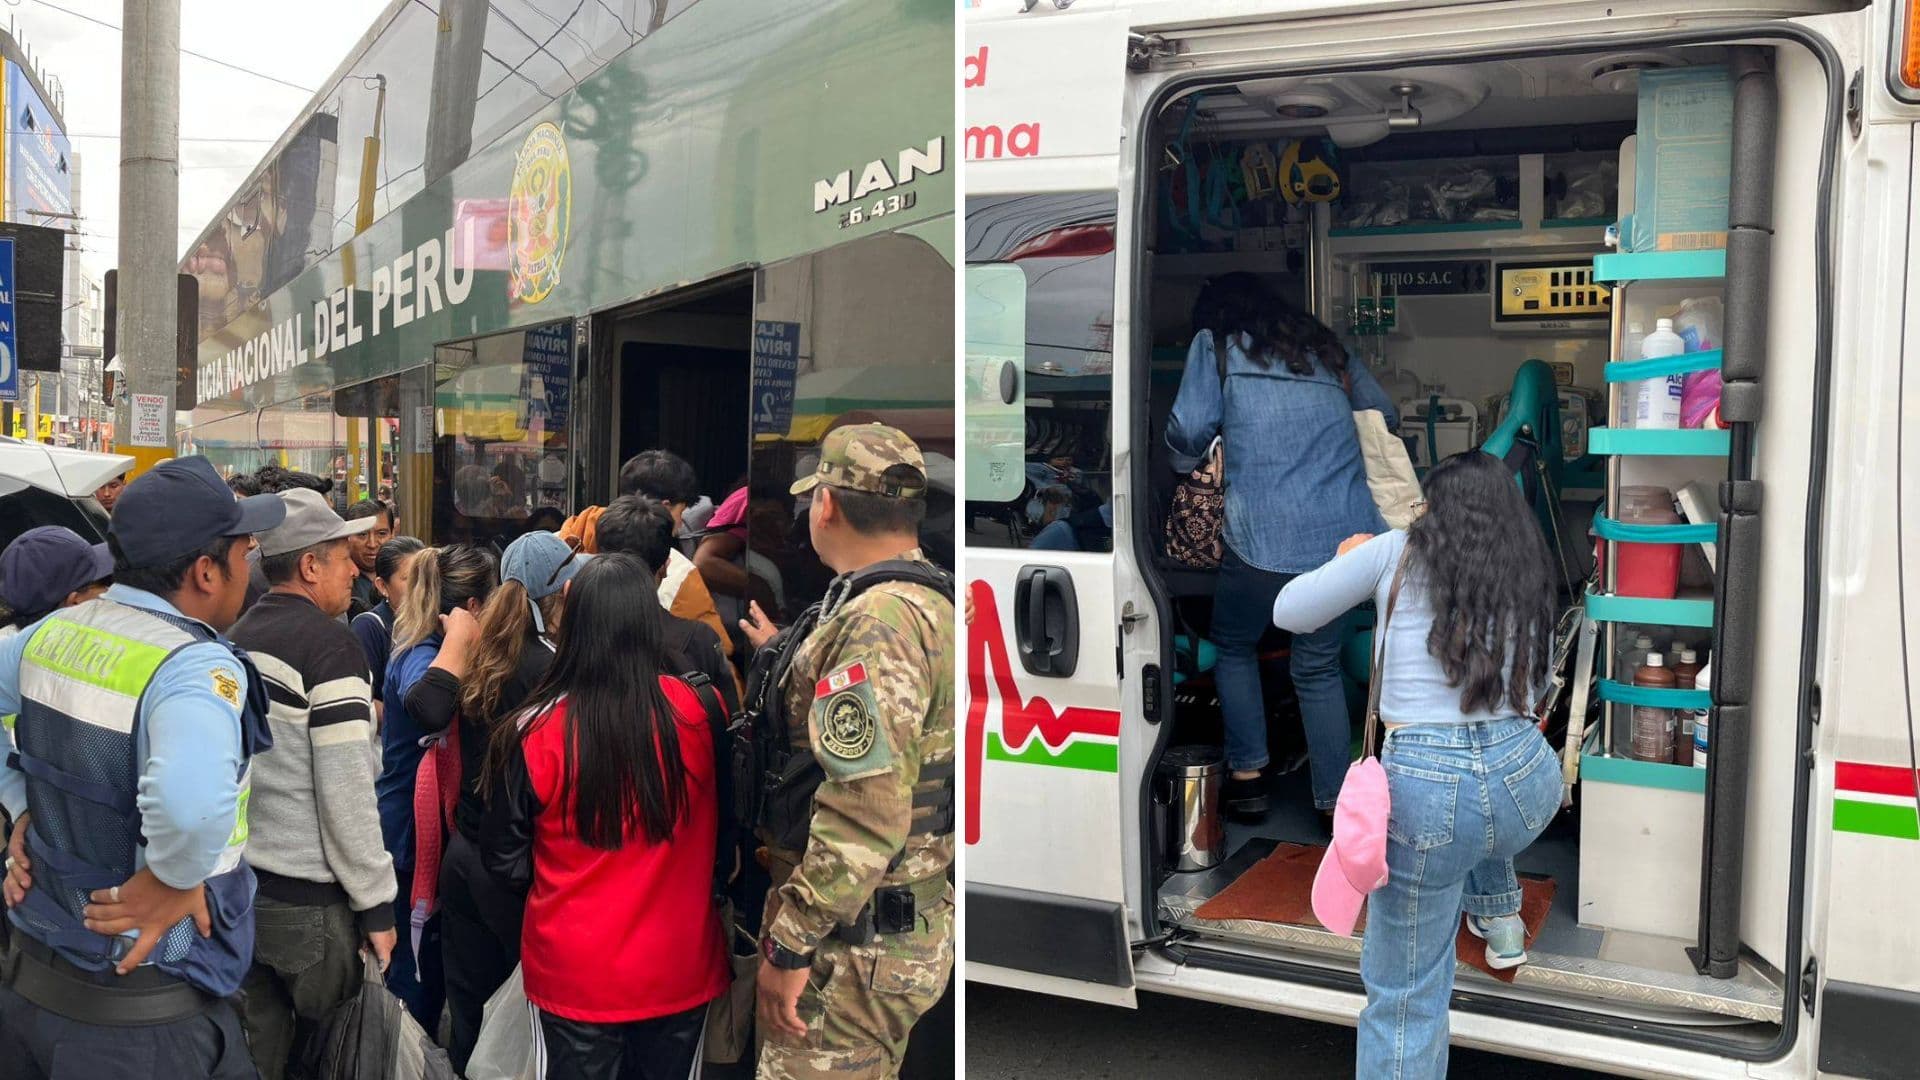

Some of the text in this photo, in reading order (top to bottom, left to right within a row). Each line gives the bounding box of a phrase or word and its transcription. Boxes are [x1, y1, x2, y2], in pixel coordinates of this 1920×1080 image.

[965, 123, 1040, 159] ma
[815, 136, 945, 213] MAN
[227, 313, 307, 392] NACIONAL
[315, 284, 362, 358] DEL
[372, 216, 474, 336] PERU
[136, 396, 164, 404] VENDO
